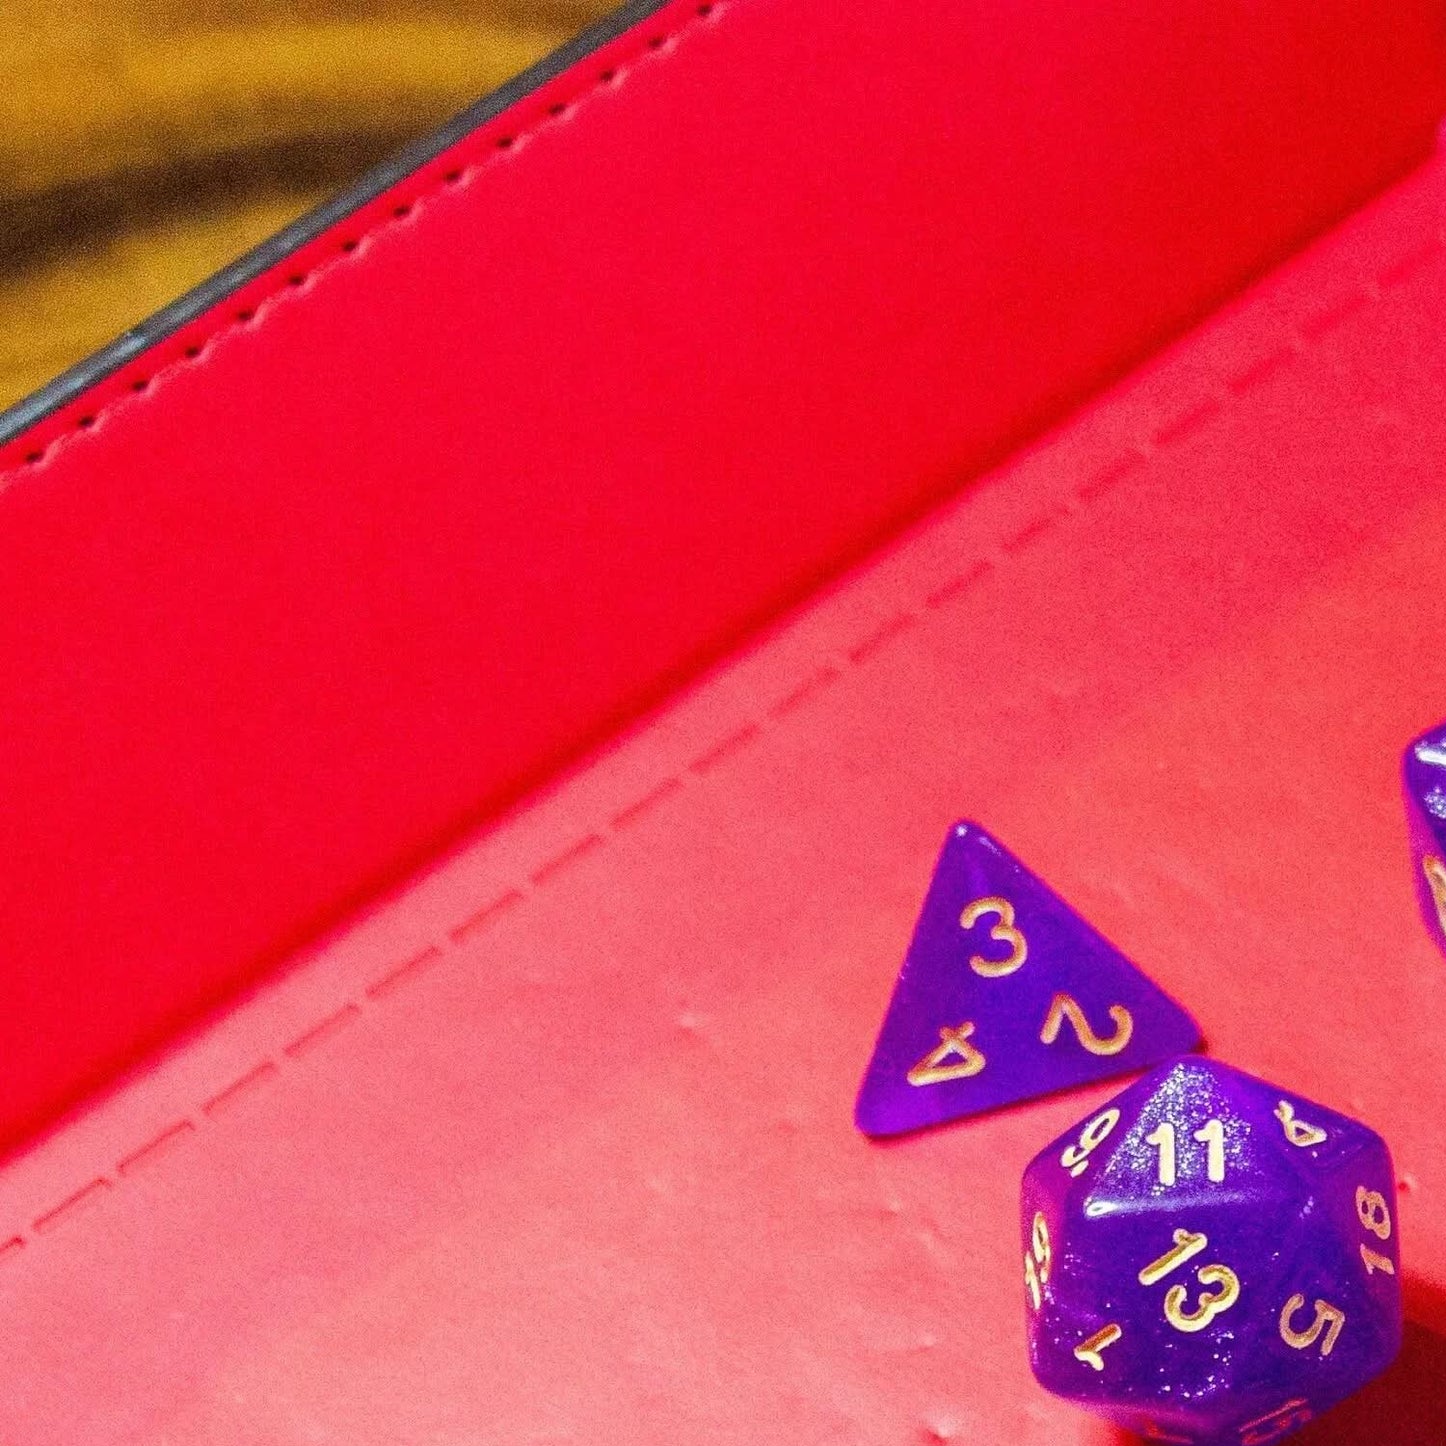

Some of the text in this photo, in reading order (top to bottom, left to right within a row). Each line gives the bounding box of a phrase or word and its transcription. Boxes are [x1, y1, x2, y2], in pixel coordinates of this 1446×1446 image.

[959, 896, 1028, 978] 3
[907, 1021, 986, 1087] 4
[1040, 993, 1134, 1056] 2
[1146, 1119, 1227, 1187] 11
[1273, 1100, 1327, 1147] 4
[1355, 1185, 1396, 1276] 18
[1138, 1227, 1241, 1333] 13
[1073, 1322, 1122, 1371] 1
[1279, 1293, 1345, 1356] 5
